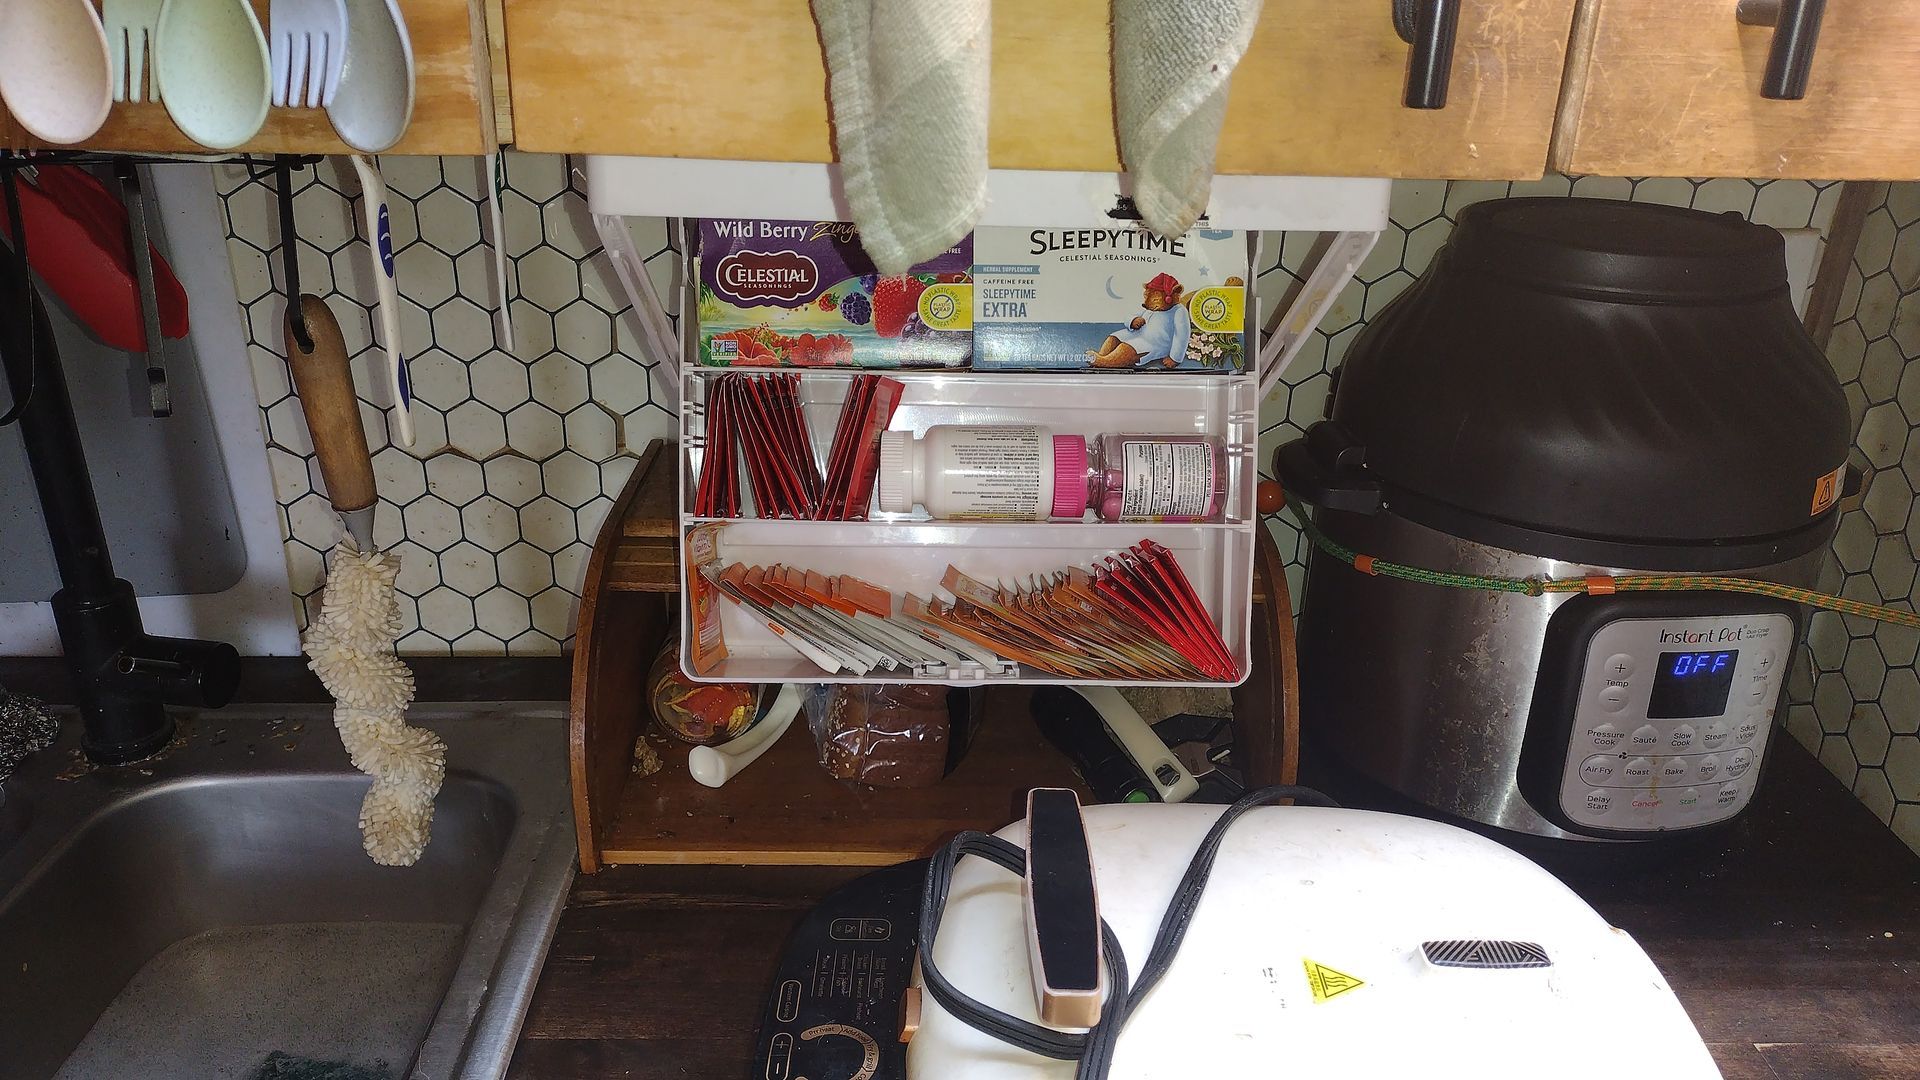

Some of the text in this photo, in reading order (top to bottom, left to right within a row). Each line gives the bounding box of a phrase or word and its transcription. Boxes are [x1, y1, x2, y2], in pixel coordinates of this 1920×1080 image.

[714, 221, 859, 243] Wild Berry Zing
[1030, 229, 1186, 258] SLEEPYTIME
[1104, 255, 1157, 264] SEASONINGS
[725, 263, 809, 286] CELESTIAL
[983, 289, 1036, 299] SLEEPYTIME
[1199, 290, 1220, 299] PLASTIC
[983, 302, 1027, 317] EXTRA
[1659, 627, 1742, 643] Instant Pot
[1674, 655, 1729, 676] OFF
[1606, 679, 1629, 688] Temp
[1587, 729, 1625, 738] Pressure
[1705, 733, 1727, 741] Steam
[1594, 738, 1616, 746] Cook
[1633, 736, 1657, 744] Sauté
[1600, 766, 1613, 775] Fry
[1700, 764, 1717, 773] Broil
[1719, 789, 1737, 797] Keep
[1587, 795, 1611, 804] Delay
[1631, 800, 1659, 808] Cancel
